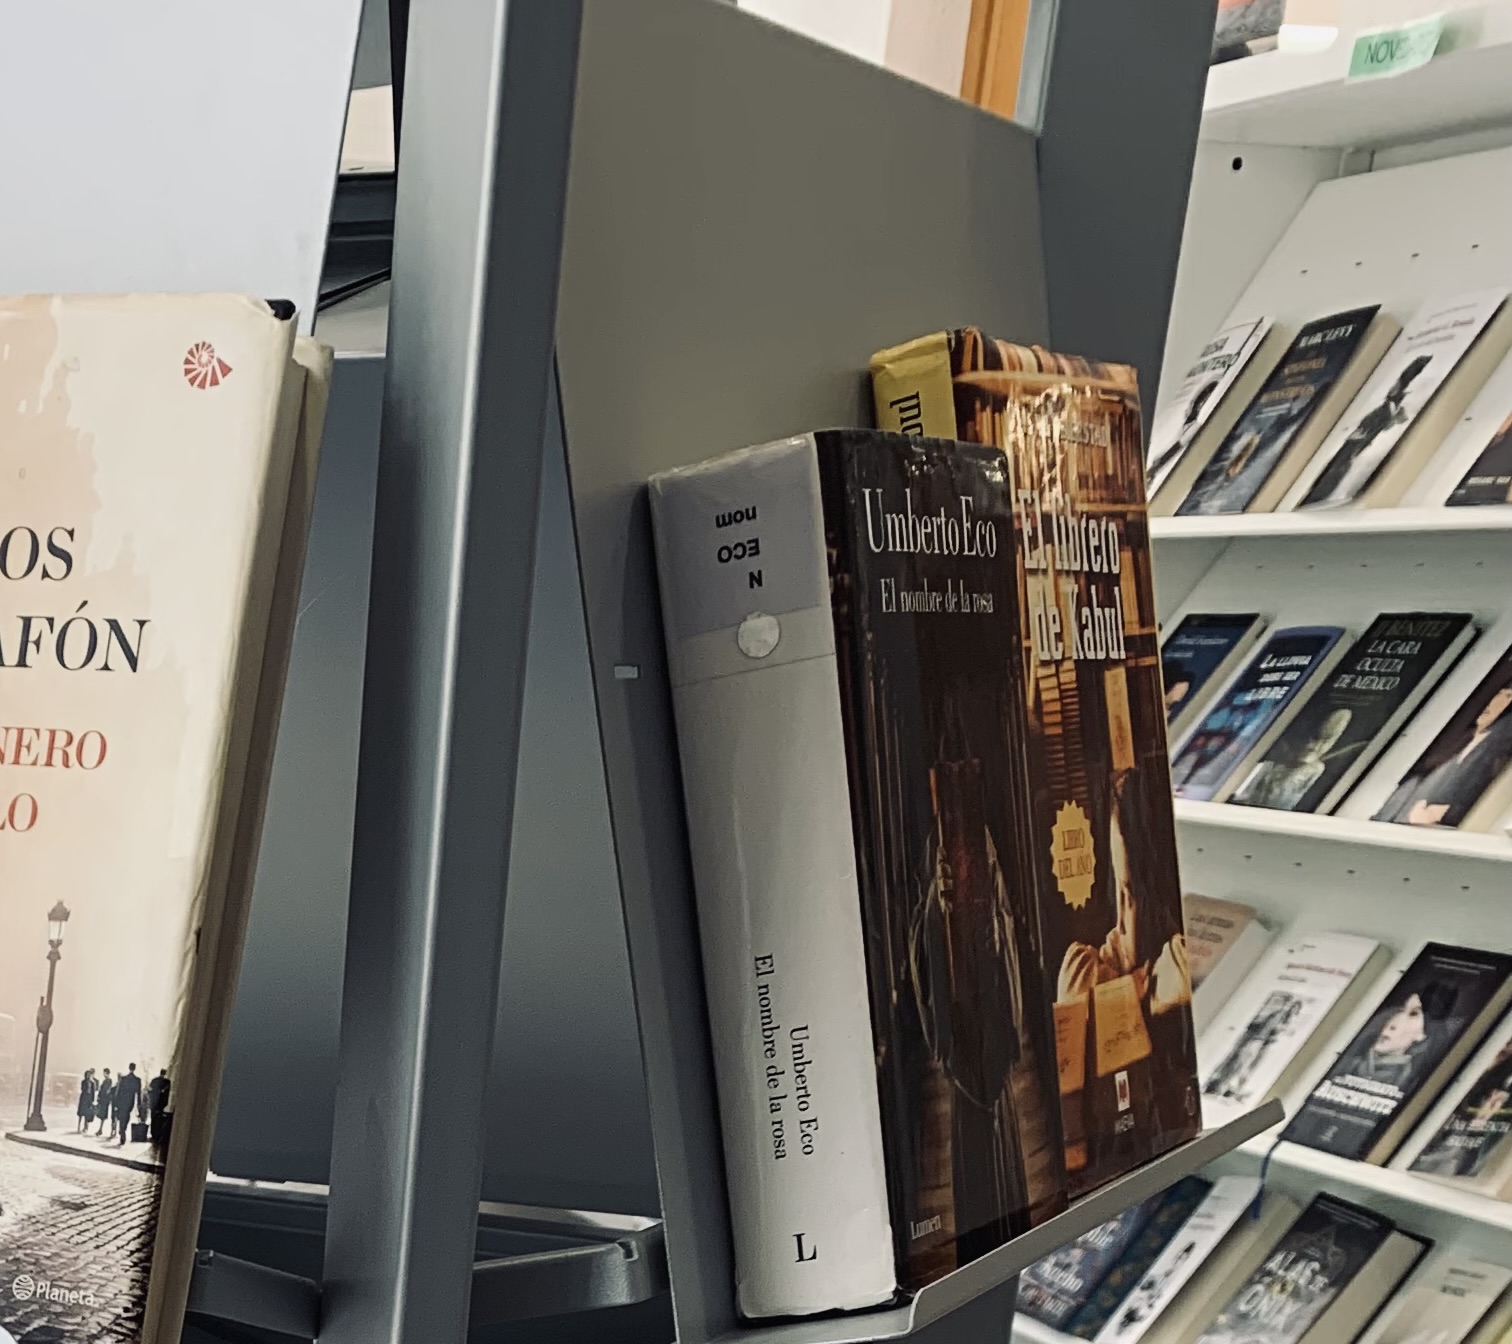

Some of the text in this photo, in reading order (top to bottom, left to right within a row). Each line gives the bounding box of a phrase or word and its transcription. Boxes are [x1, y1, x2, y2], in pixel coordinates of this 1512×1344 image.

[715, 505, 757, 528] nom
[862, 488, 997, 557] Umberto Eco
[1051, 490, 1120, 574] librero
[717, 537, 760, 564] ECO
[749, 569, 763, 589] N
[880, 578, 994, 613] El nombre de la rosa
[1035, 584, 1126, 662] de Kabul
[754, 953, 788, 1160] El nombre de la rosa
[790, 1024, 819, 1156] Umberto Eco
[793, 1232, 817, 1263] L
[36, 1281, 96, 1307] Planeta
